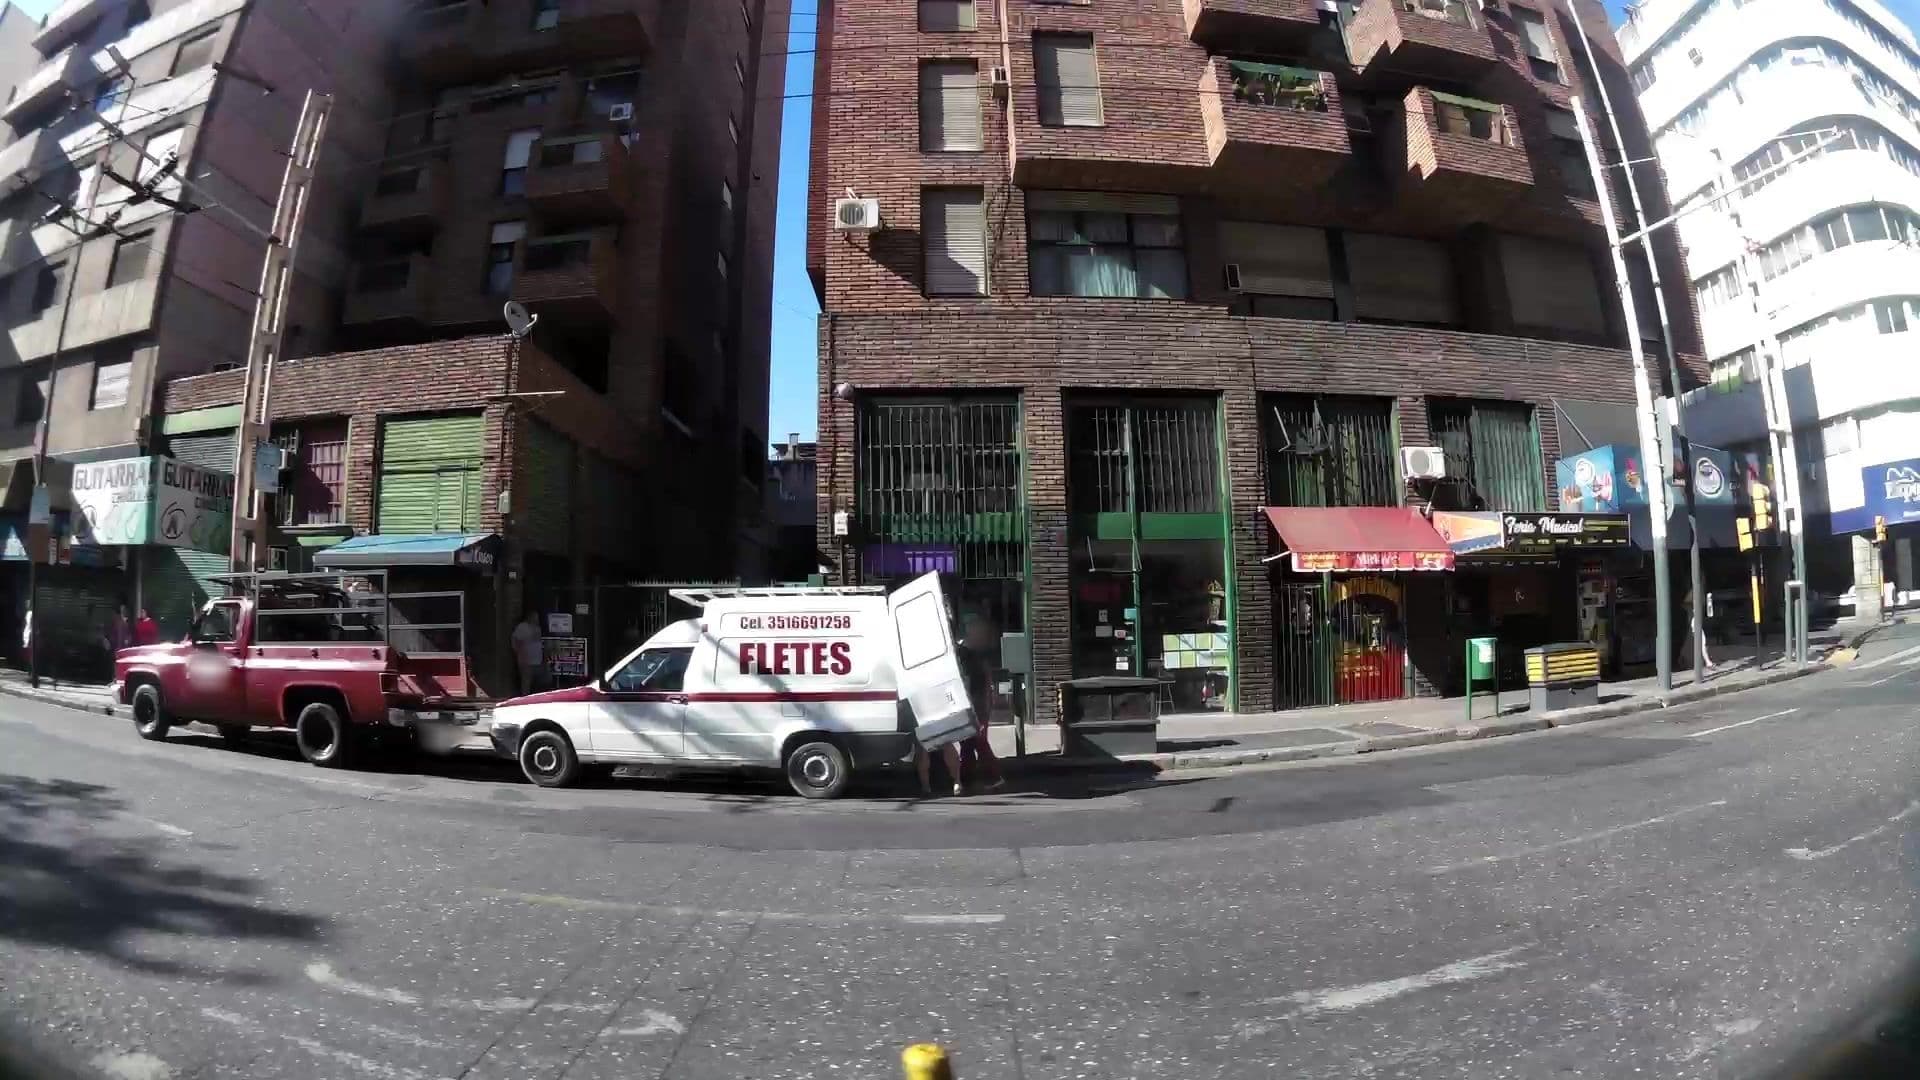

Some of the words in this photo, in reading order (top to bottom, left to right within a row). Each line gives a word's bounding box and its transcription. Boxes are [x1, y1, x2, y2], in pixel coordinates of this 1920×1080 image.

[1504, 516, 1536, 534] Feria
[1538, 515, 1583, 534] Musical
[740, 616, 764, 630] Cel.
[768, 615, 851, 630] 3516691258
[739, 641, 852, 676] FLETES
